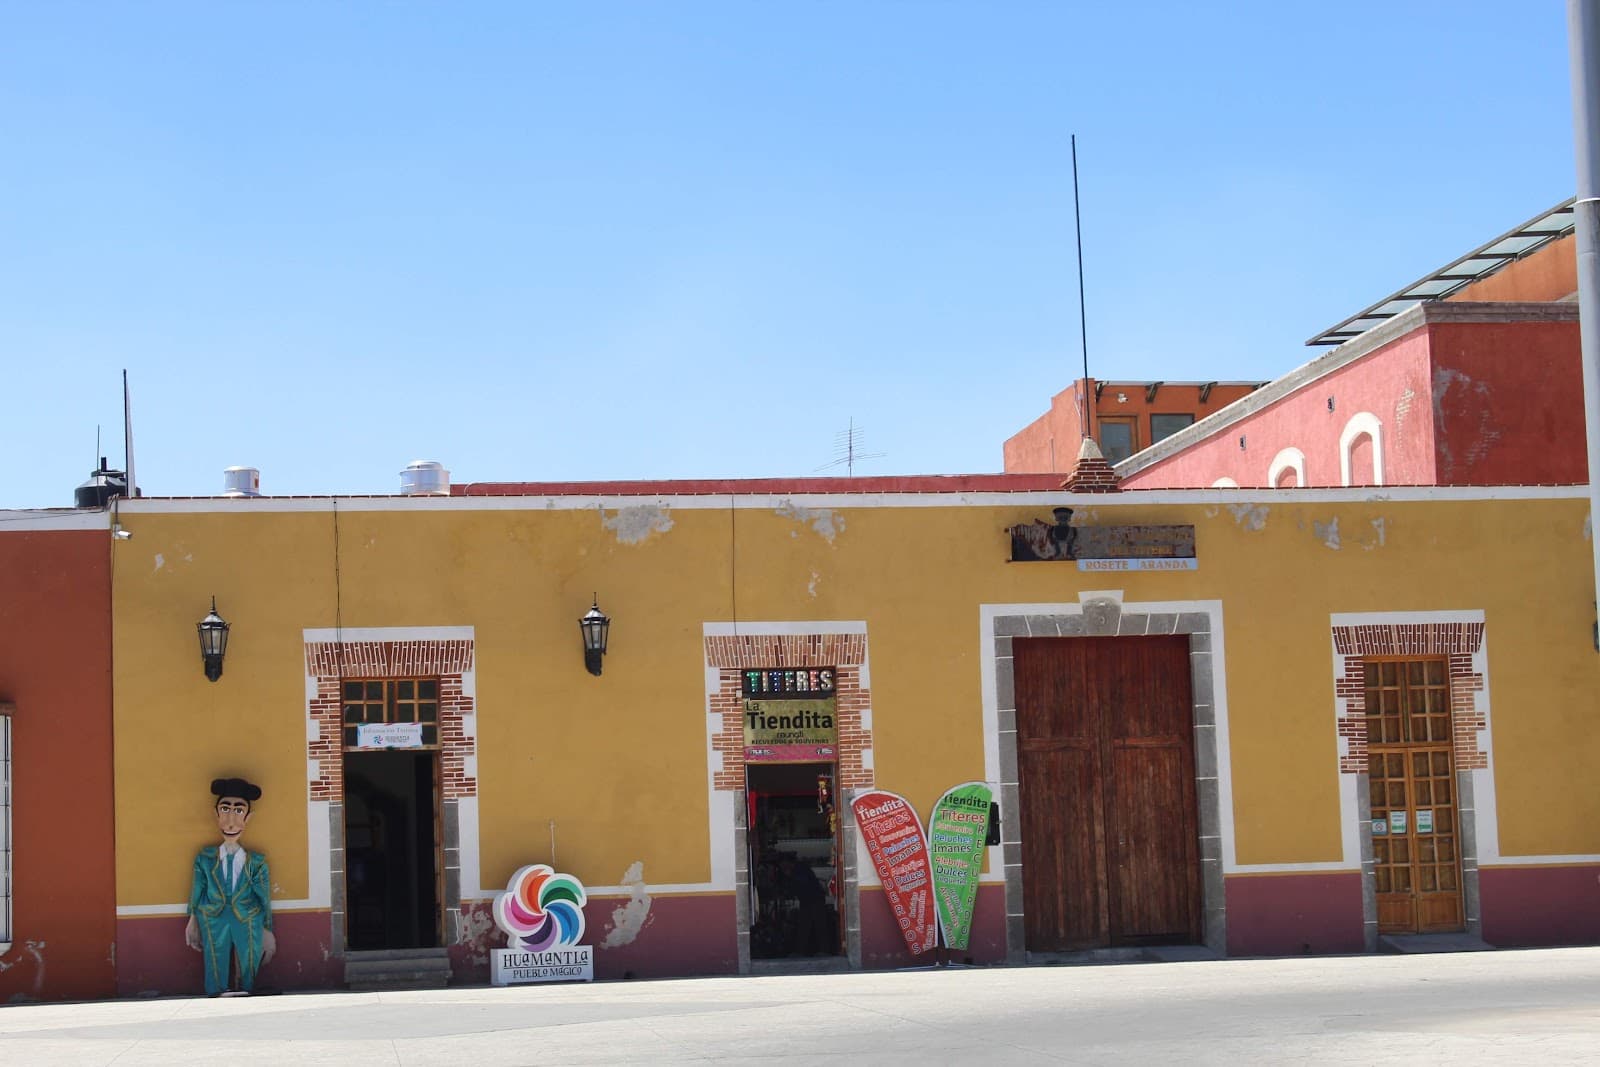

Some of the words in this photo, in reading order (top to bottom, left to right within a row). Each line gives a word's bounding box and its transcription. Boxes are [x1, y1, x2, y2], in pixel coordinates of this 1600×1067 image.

[1085, 560, 1129, 570] ROSETE
[1140, 559, 1189, 570] ARANDA
[746, 700, 760, 711] La
[746, 710, 833, 729] Tiendita
[857, 799, 905, 821] Tiendita
[886, 841, 922, 867] Imanes
[933, 843, 972, 854] Imanes
[936, 865, 968, 878] Dulces
